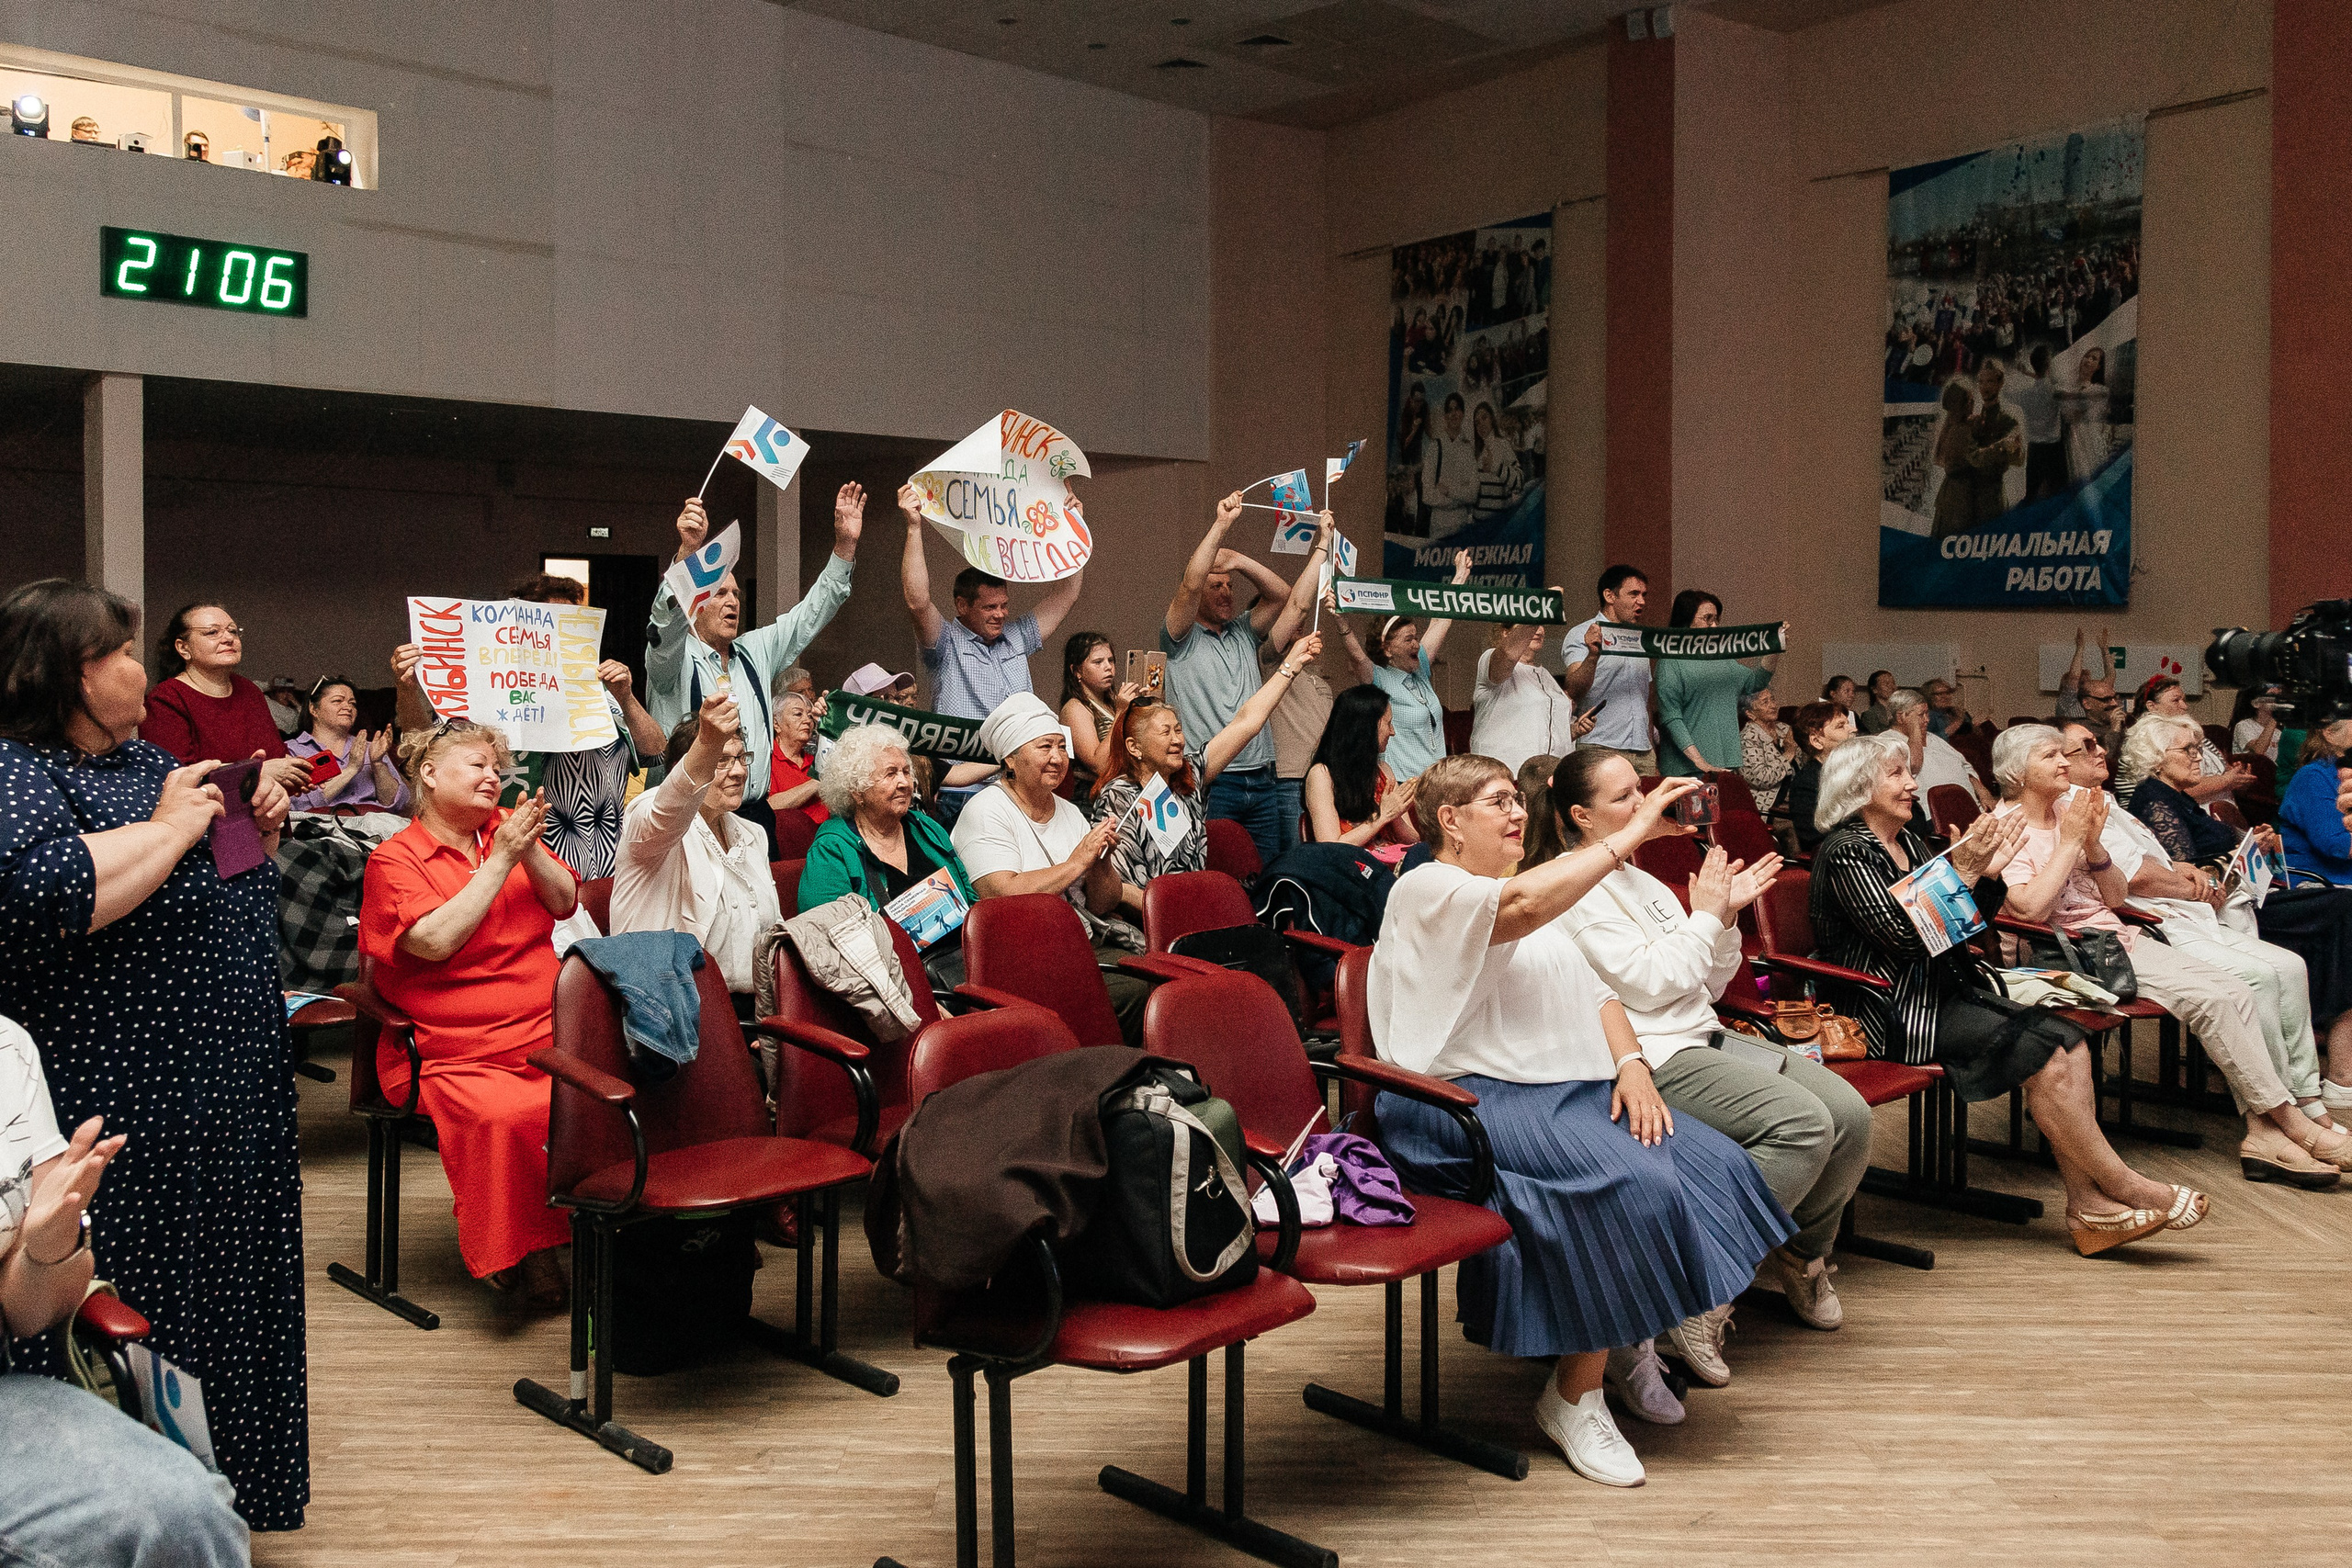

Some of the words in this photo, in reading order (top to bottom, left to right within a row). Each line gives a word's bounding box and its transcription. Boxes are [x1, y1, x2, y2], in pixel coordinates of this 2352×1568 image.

[945, 479, 1021, 529] СЕМЬЯ
[1940, 529, 2112, 561] СОЦИАЛЬНАЯ
[2005, 566, 2102, 592] РАБОТА
[1357, 590, 1389, 599] ПСПФНР
[1407, 588, 1555, 619] ЧЕЛЯБИНСК
[471, 604, 555, 630] КОМАНДА
[495, 626, 551, 651] СЕМЬЯ
[1654, 630, 1770, 655] ЧЕЛЯБИНСК
[490, 670, 560, 692] ПОБЕДА
[558, 606, 617, 747] ЧЕЛЯБИНСК
[509, 690, 537, 705] ВАС
